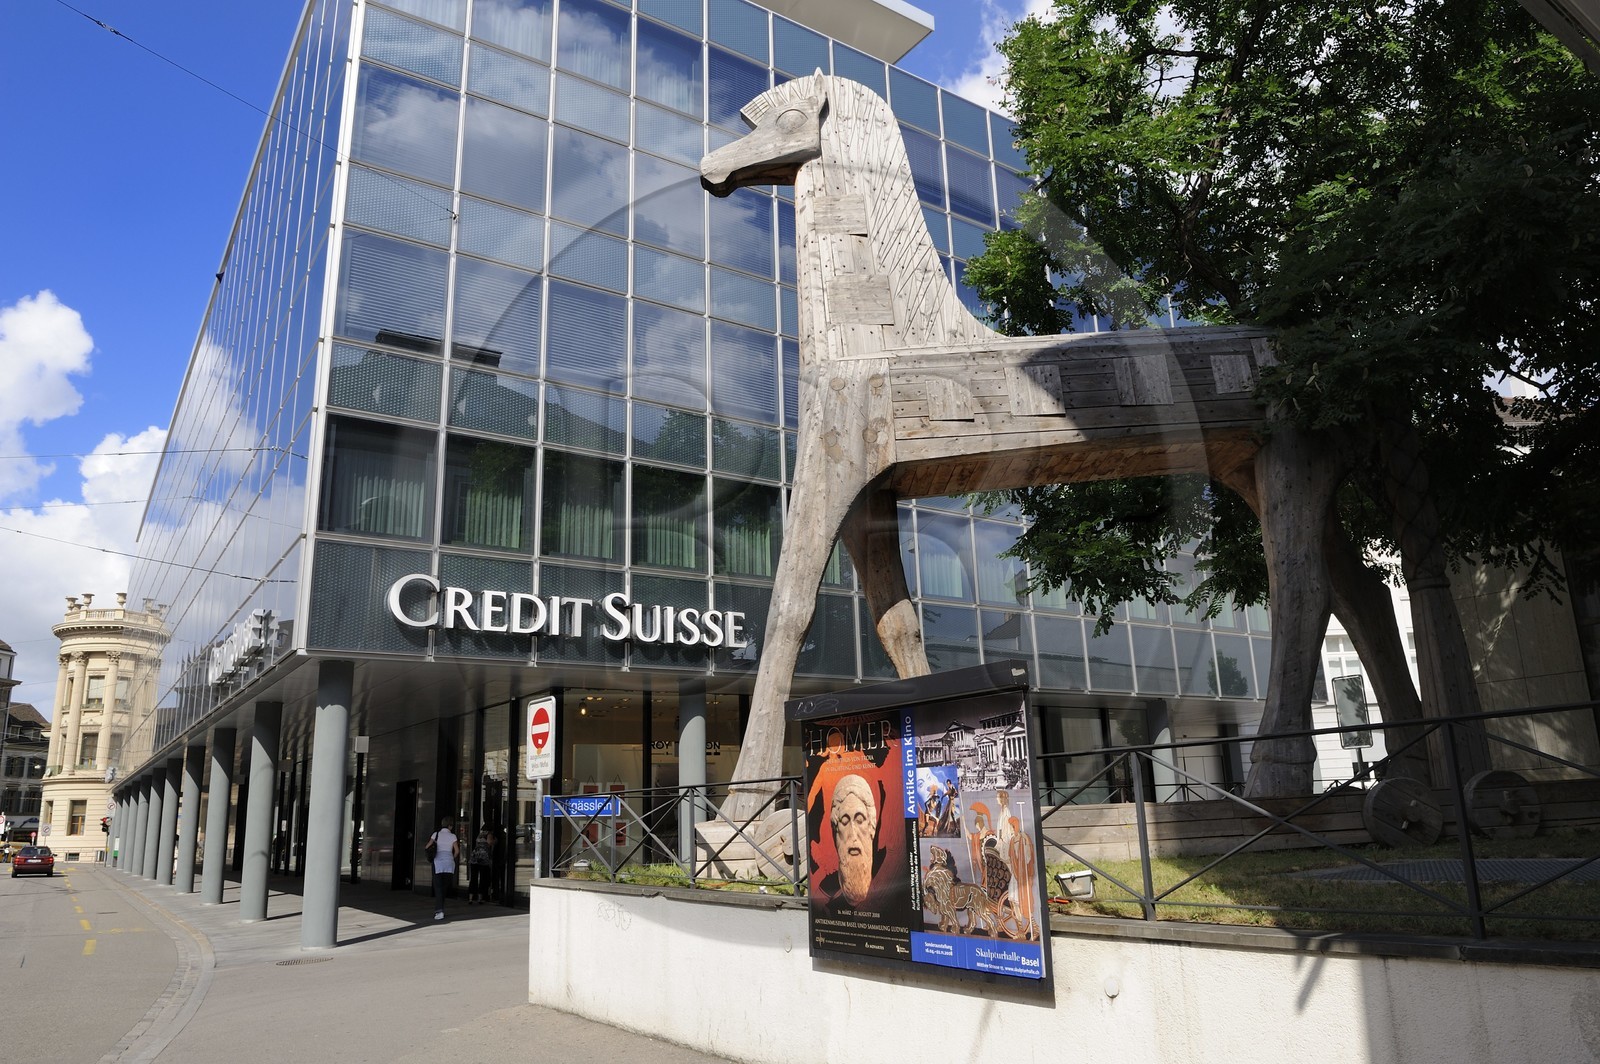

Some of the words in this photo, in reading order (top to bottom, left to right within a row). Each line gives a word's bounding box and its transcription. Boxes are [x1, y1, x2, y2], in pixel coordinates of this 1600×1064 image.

[387, 573, 593, 637] CREDIT
[602, 592, 748, 648] SUISSE
[809, 720, 898, 756] HOMER
[904, 716, 913, 746] Kino
[905, 749, 914, 767] im
[905, 769, 916, 814] Antike
[975, 947, 1021, 962] Skulpturhalle
[1021, 956, 1040, 967] Basel
